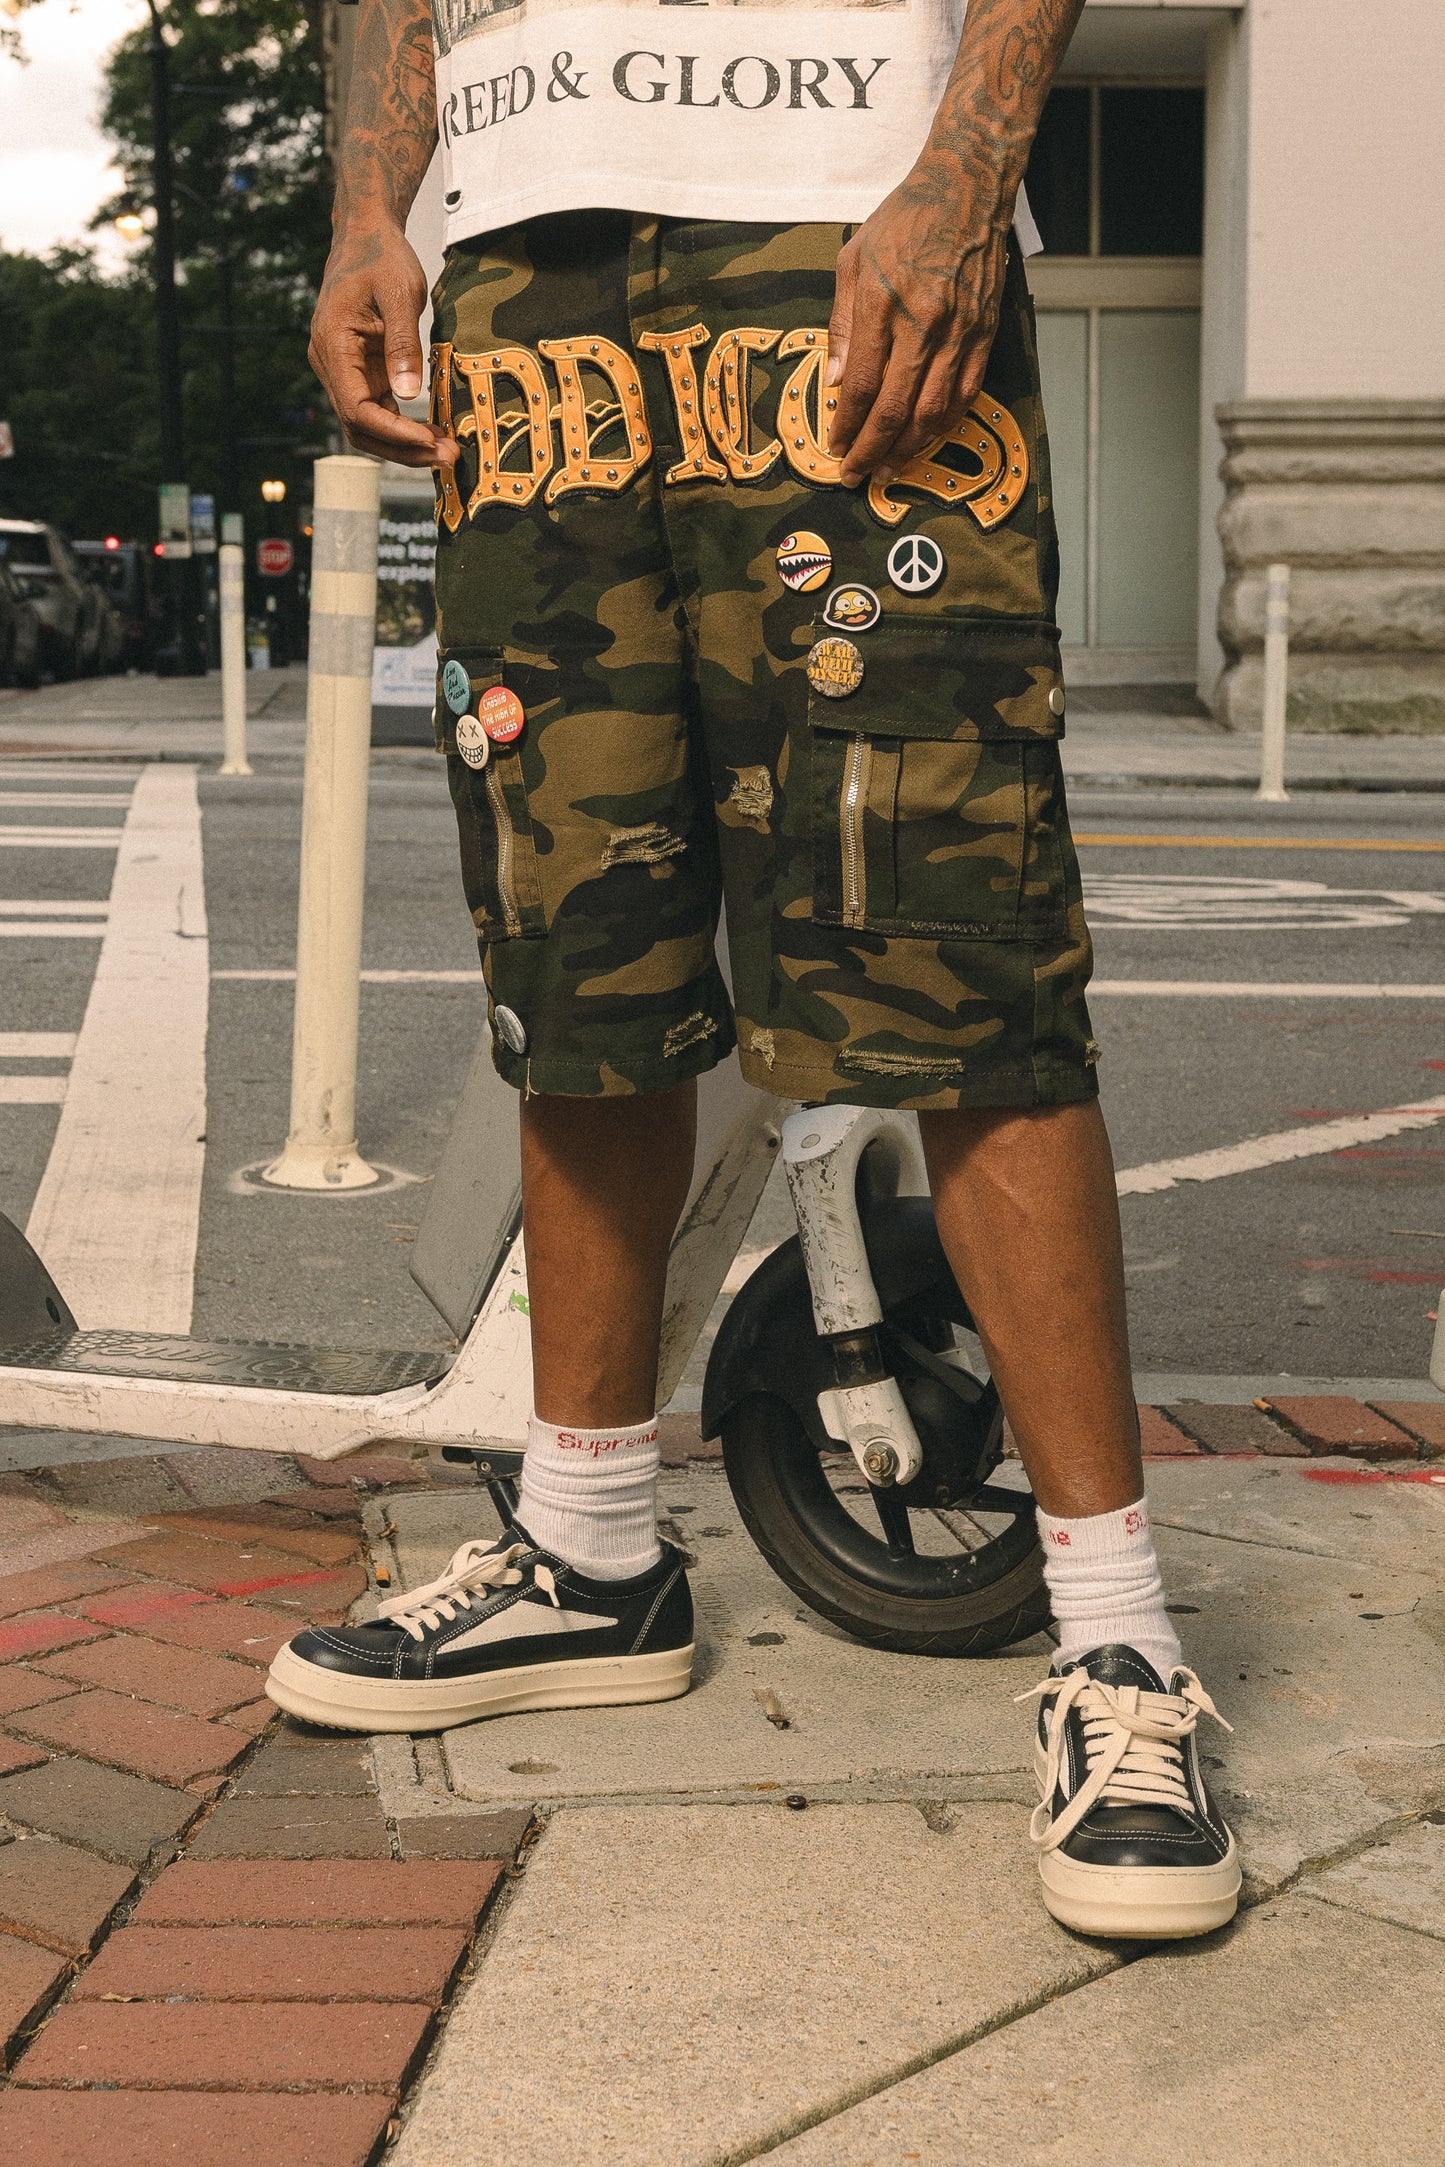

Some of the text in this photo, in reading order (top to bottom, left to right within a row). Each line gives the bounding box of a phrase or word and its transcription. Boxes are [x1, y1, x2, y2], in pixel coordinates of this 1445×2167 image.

[547, 51, 590, 103] &
[612, 50, 892, 110] GLORY
[818, 655, 853, 672] WITH
[809, 666, 860, 686] MYSELF
[557, 1429, 659, 1458] Supreme
